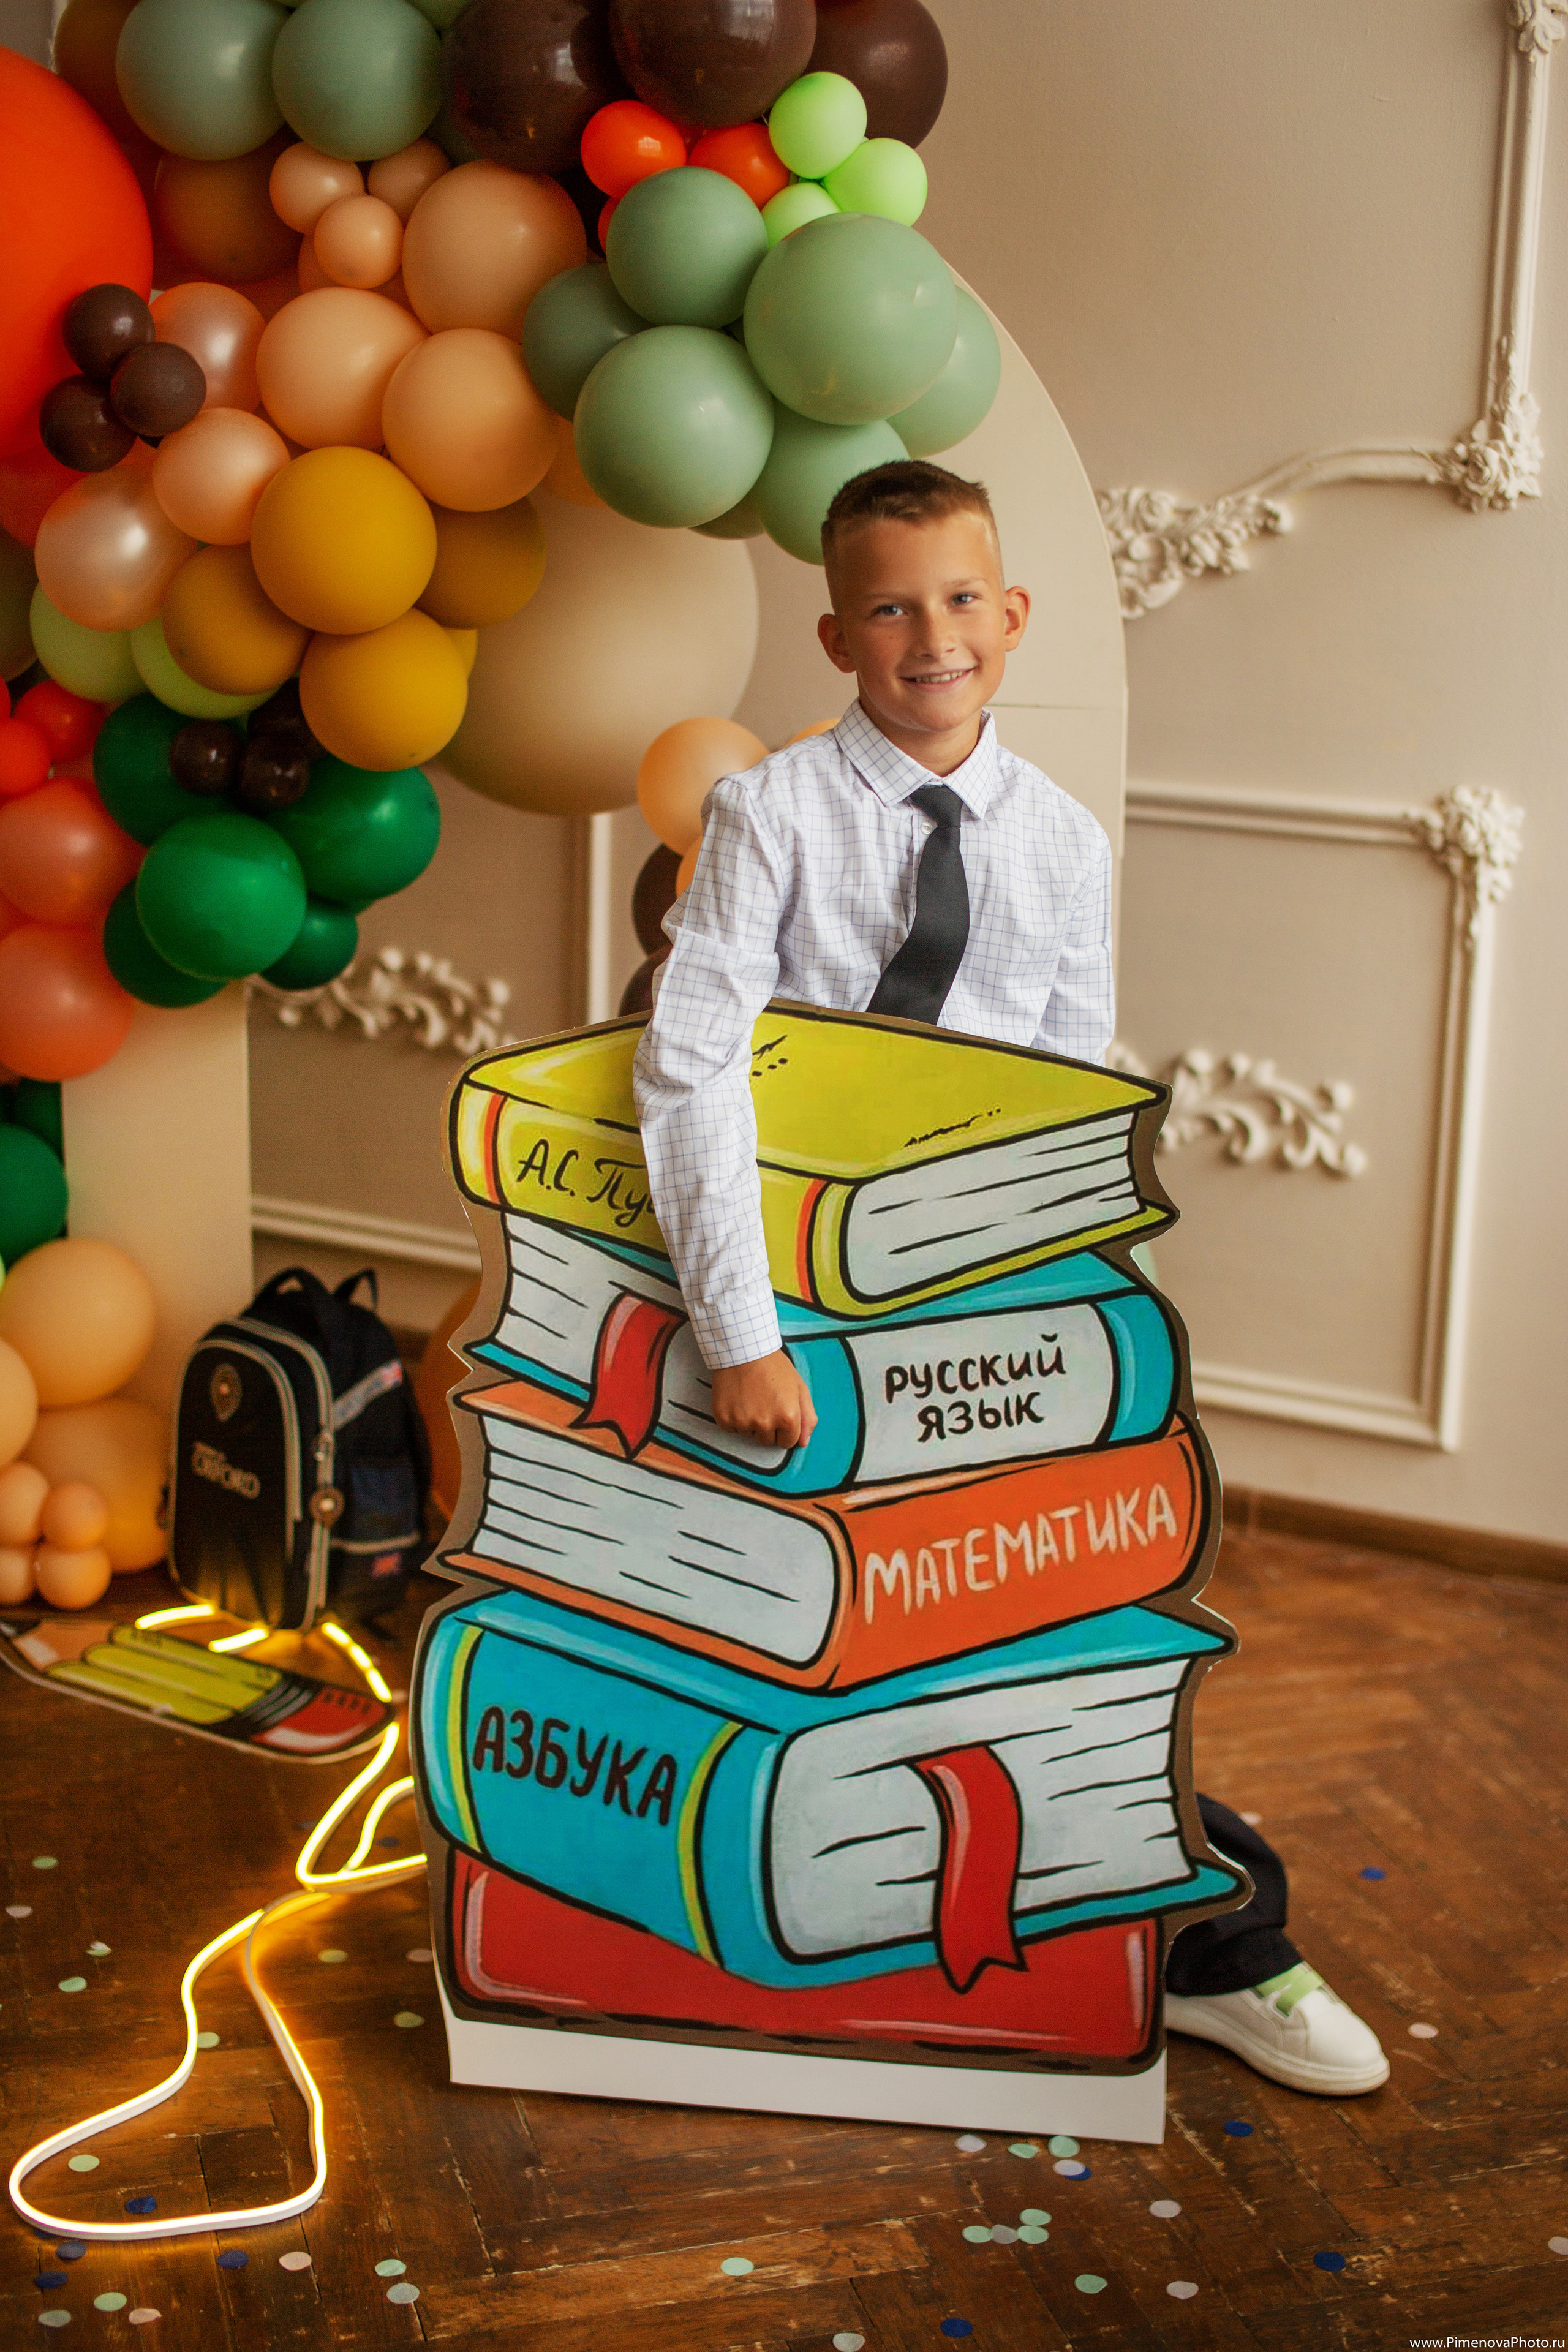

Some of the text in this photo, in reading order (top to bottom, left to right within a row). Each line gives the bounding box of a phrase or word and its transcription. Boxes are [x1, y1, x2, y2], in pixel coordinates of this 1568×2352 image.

[917, 1391, 1044, 1443] ЯЗЫК
[864, 1483, 1177, 1625] МАТЕМАТИКА
[472, 1705, 677, 1826] АЗБУКА
